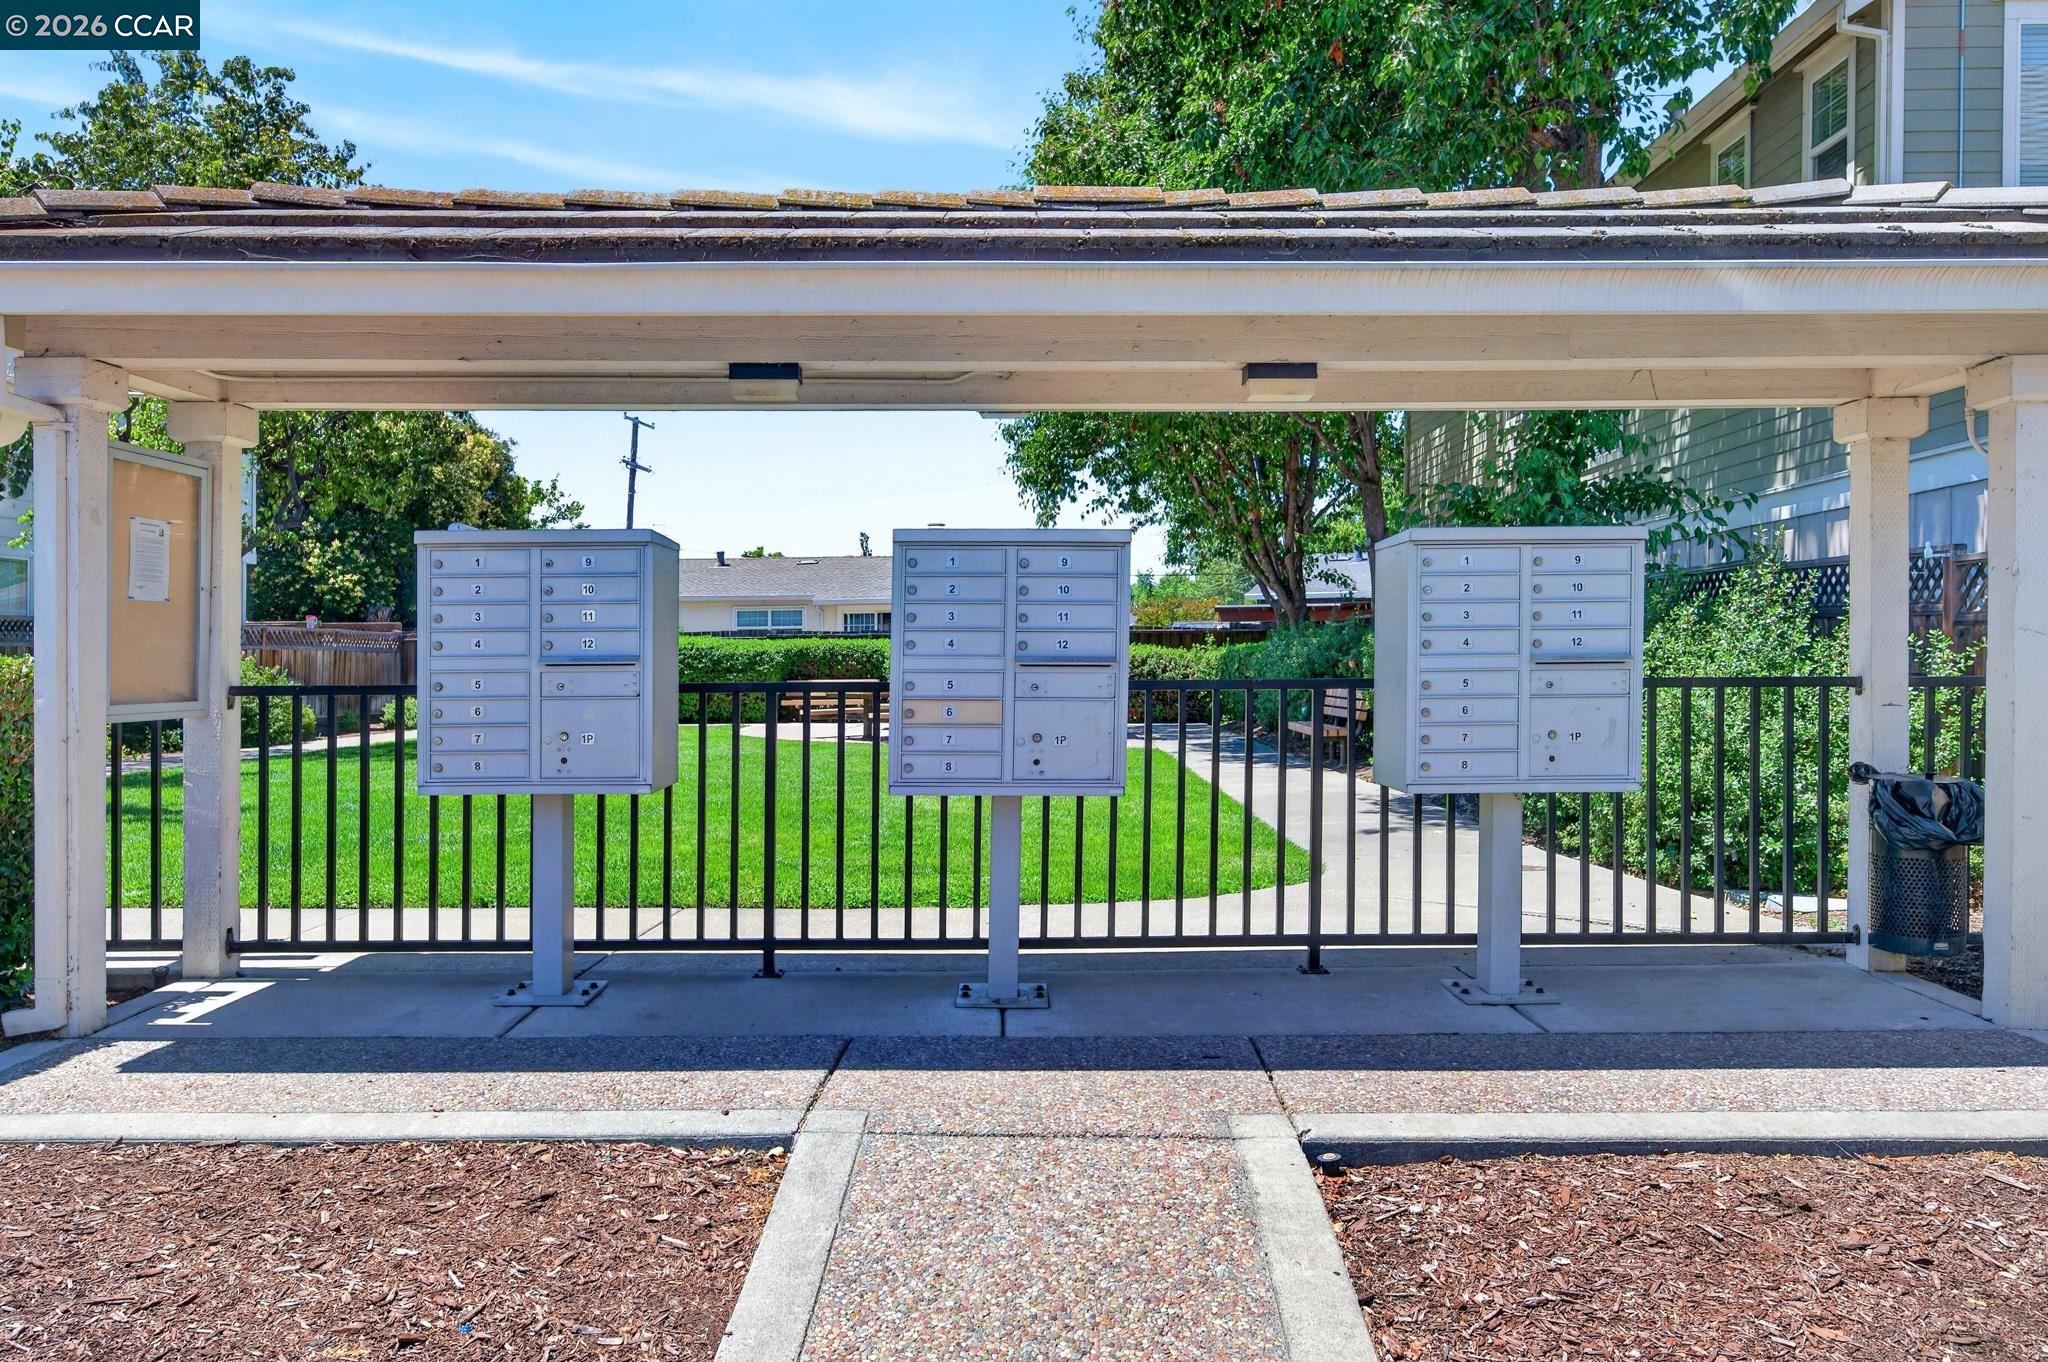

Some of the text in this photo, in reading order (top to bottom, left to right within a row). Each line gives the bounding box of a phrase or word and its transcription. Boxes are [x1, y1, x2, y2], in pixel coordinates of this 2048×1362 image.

[585, 558, 592, 567] 9
[1061, 558, 1068, 567] 9
[1574, 556, 1581, 565] 9
[474, 586, 482, 595] 2
[582, 585, 595, 594] 10
[948, 585, 956, 594] 2
[1058, 586, 1070, 595] 10
[1463, 584, 1470, 593] 2
[1571, 583, 1583, 592] 10
[474, 613, 481, 622] 3
[582, 612, 595, 621] 11
[948, 612, 955, 621] 3
[1057, 613, 1069, 622] 11
[1463, 611, 1470, 620] 3
[1571, 610, 1582, 619] 11
[474, 640, 481, 649] 4
[582, 640, 594, 649] 12
[947, 640, 954, 648] 4
[1057, 640, 1069, 650] 12
[1462, 638, 1470, 647] 4
[1571, 638, 1583, 647] 12
[474, 681, 481, 690] 5
[947, 681, 954, 690] 5
[1462, 679, 1469, 688] 5
[474, 708, 481, 717] 6
[946, 708, 953, 717] 6
[1462, 706, 1469, 715] 6
[474, 735, 482, 744] 7
[581, 735, 594, 744] 1P
[946, 736, 952, 744] 7
[1054, 736, 1067, 745] 1P
[1461, 734, 1468, 742] 7
[1569, 732, 1582, 742] 1P
[474, 762, 481, 771] 8
[945, 762, 952, 772] 8
[1461, 761, 1468, 770] 8
